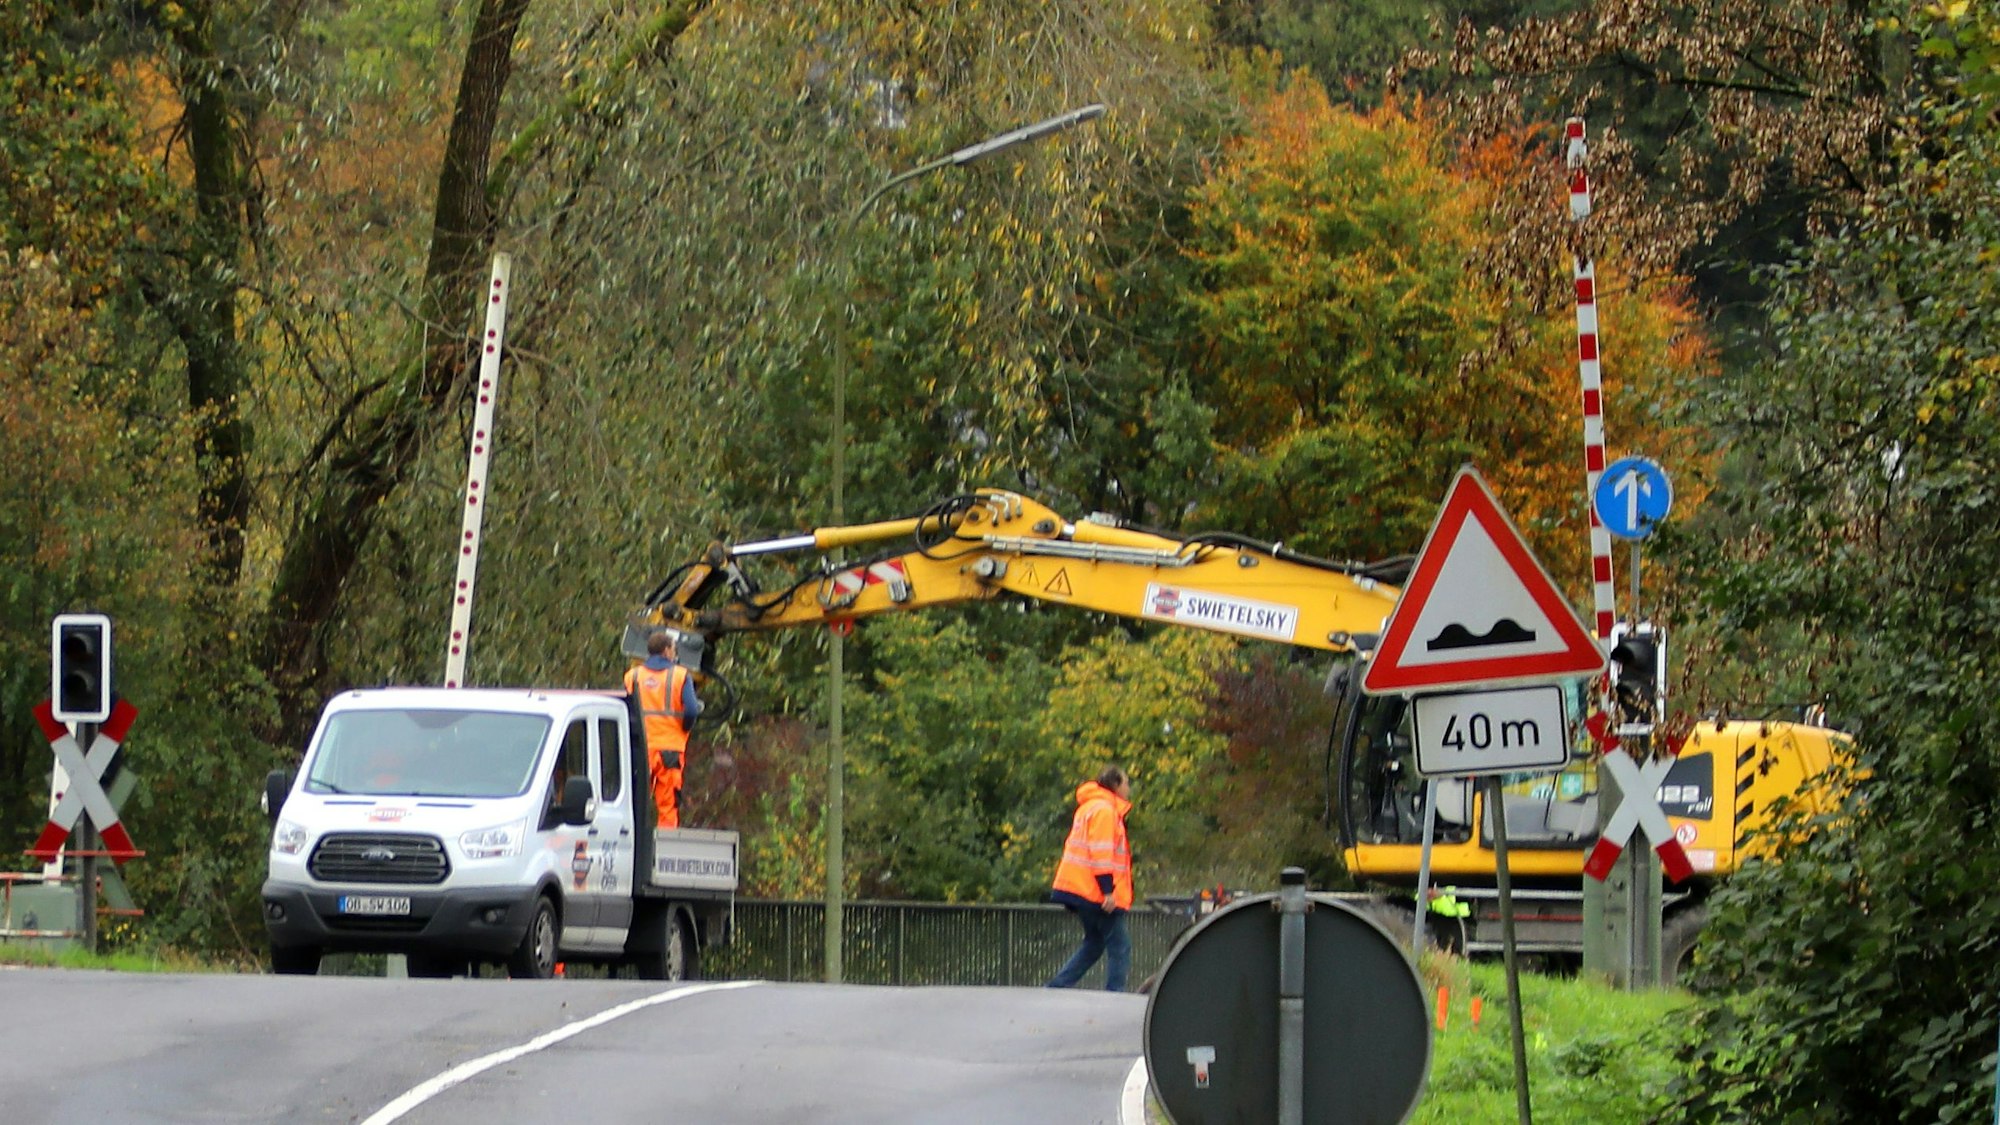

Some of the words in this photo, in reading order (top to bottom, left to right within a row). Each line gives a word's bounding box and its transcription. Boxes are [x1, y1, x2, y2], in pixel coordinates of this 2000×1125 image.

[1187, 597, 1287, 631] SWIETELSKY
[1441, 713, 1491, 751] 40
[1501, 719, 1539, 748] m
